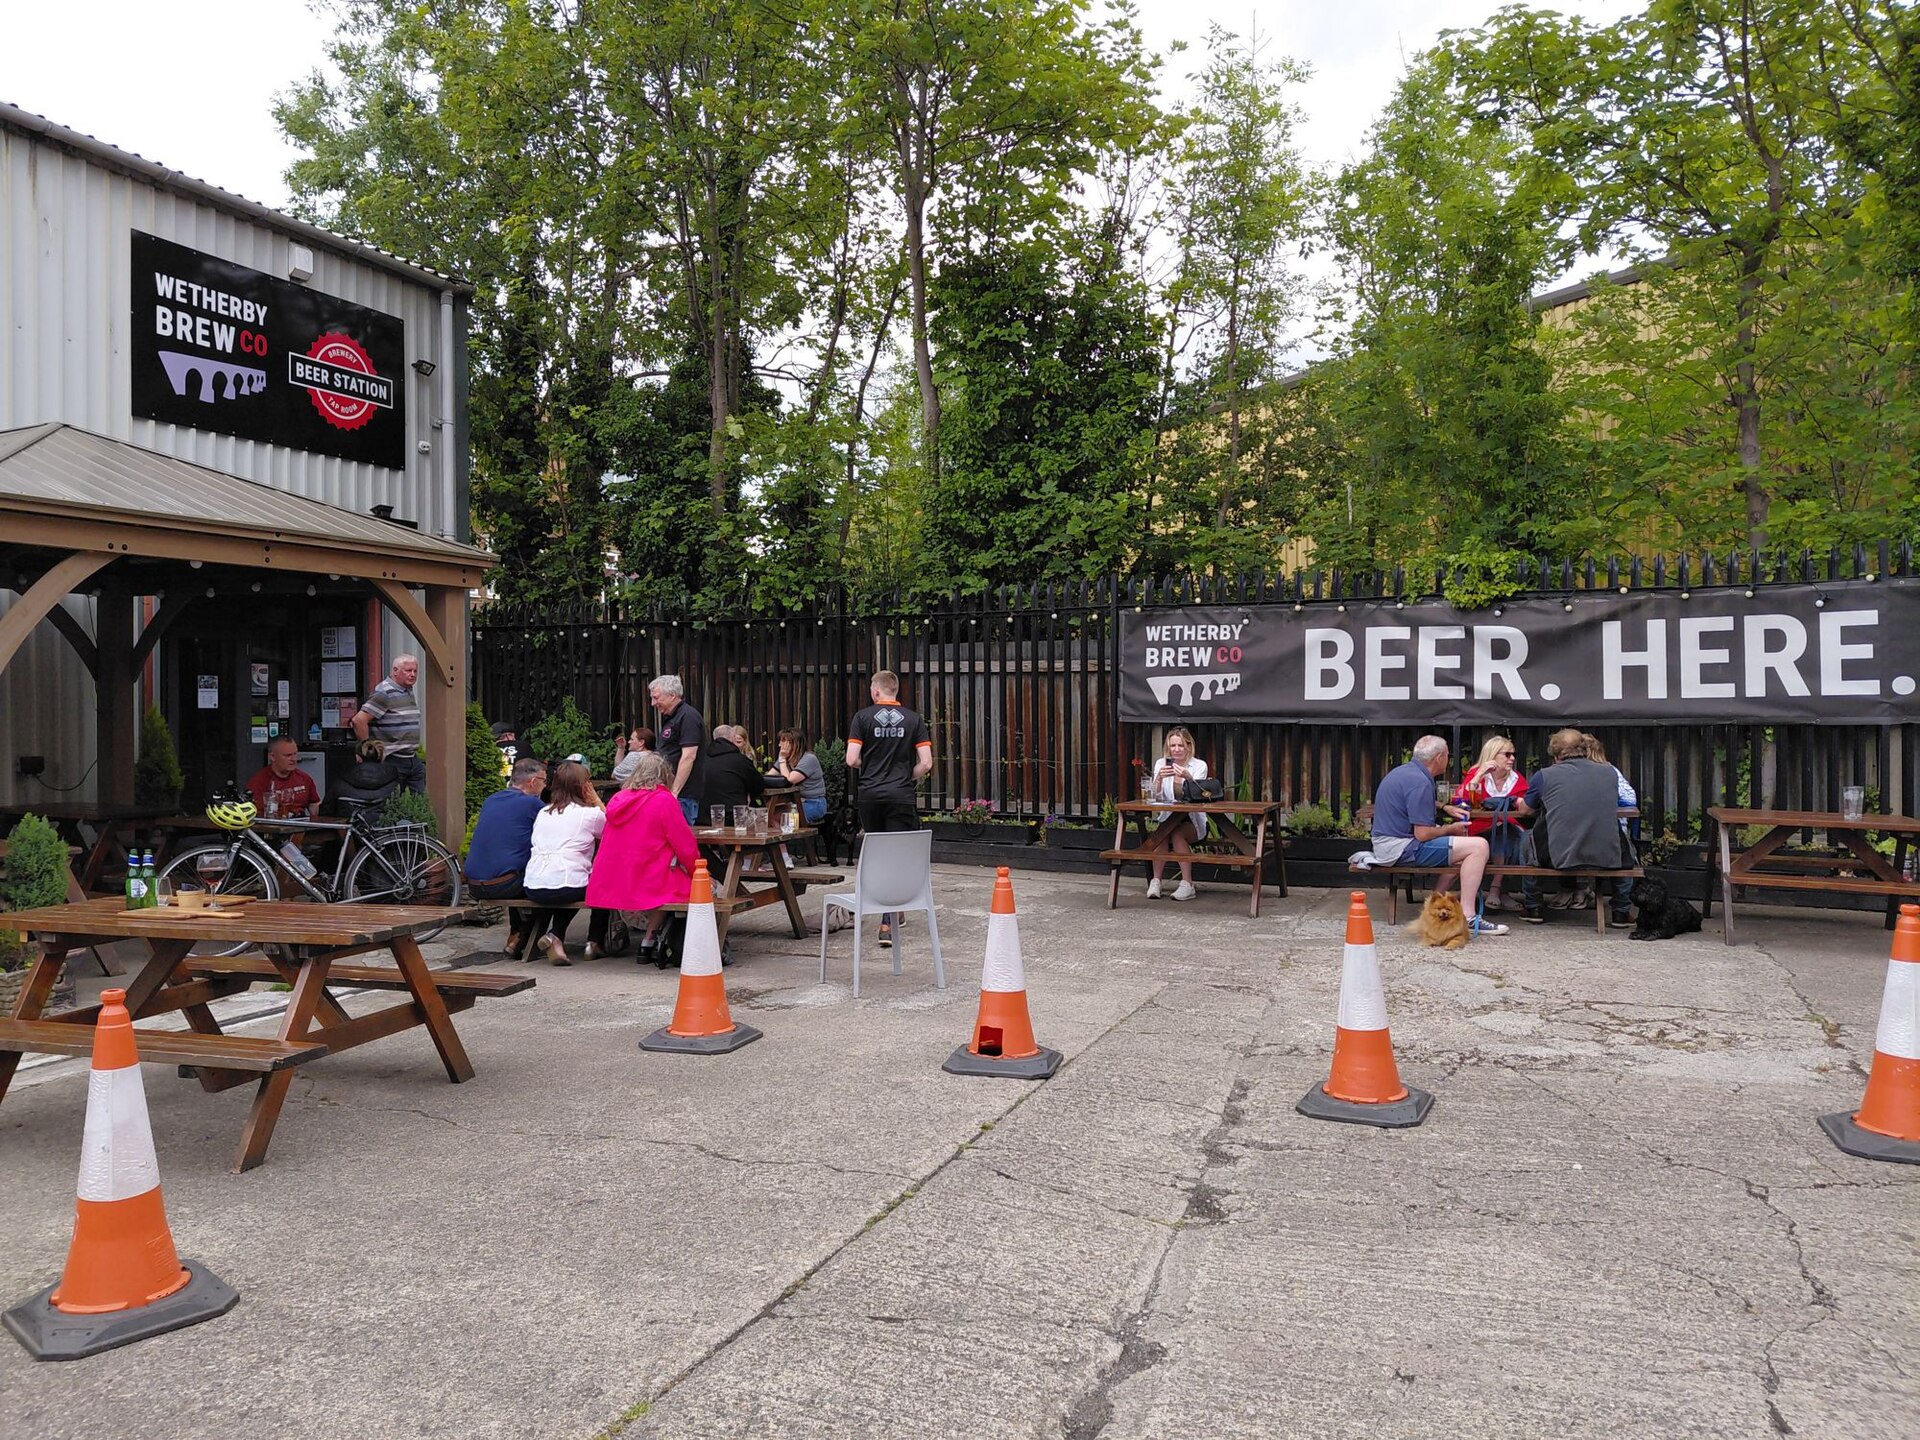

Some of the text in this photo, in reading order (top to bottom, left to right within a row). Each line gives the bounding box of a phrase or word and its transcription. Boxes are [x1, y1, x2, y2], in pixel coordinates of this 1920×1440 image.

[155, 272, 268, 326] WETHERBY
[155, 305, 268, 357] BREW CO
[329, 349, 357, 364] BREWERY
[296, 361, 387, 400] BEER STATION
[328, 396, 358, 414] TAP ROOM
[1145, 624, 1243, 642] WETHERBY
[1145, 645, 1242, 667] BREW CO
[1304, 609, 1918, 701] BEER. HERE.
